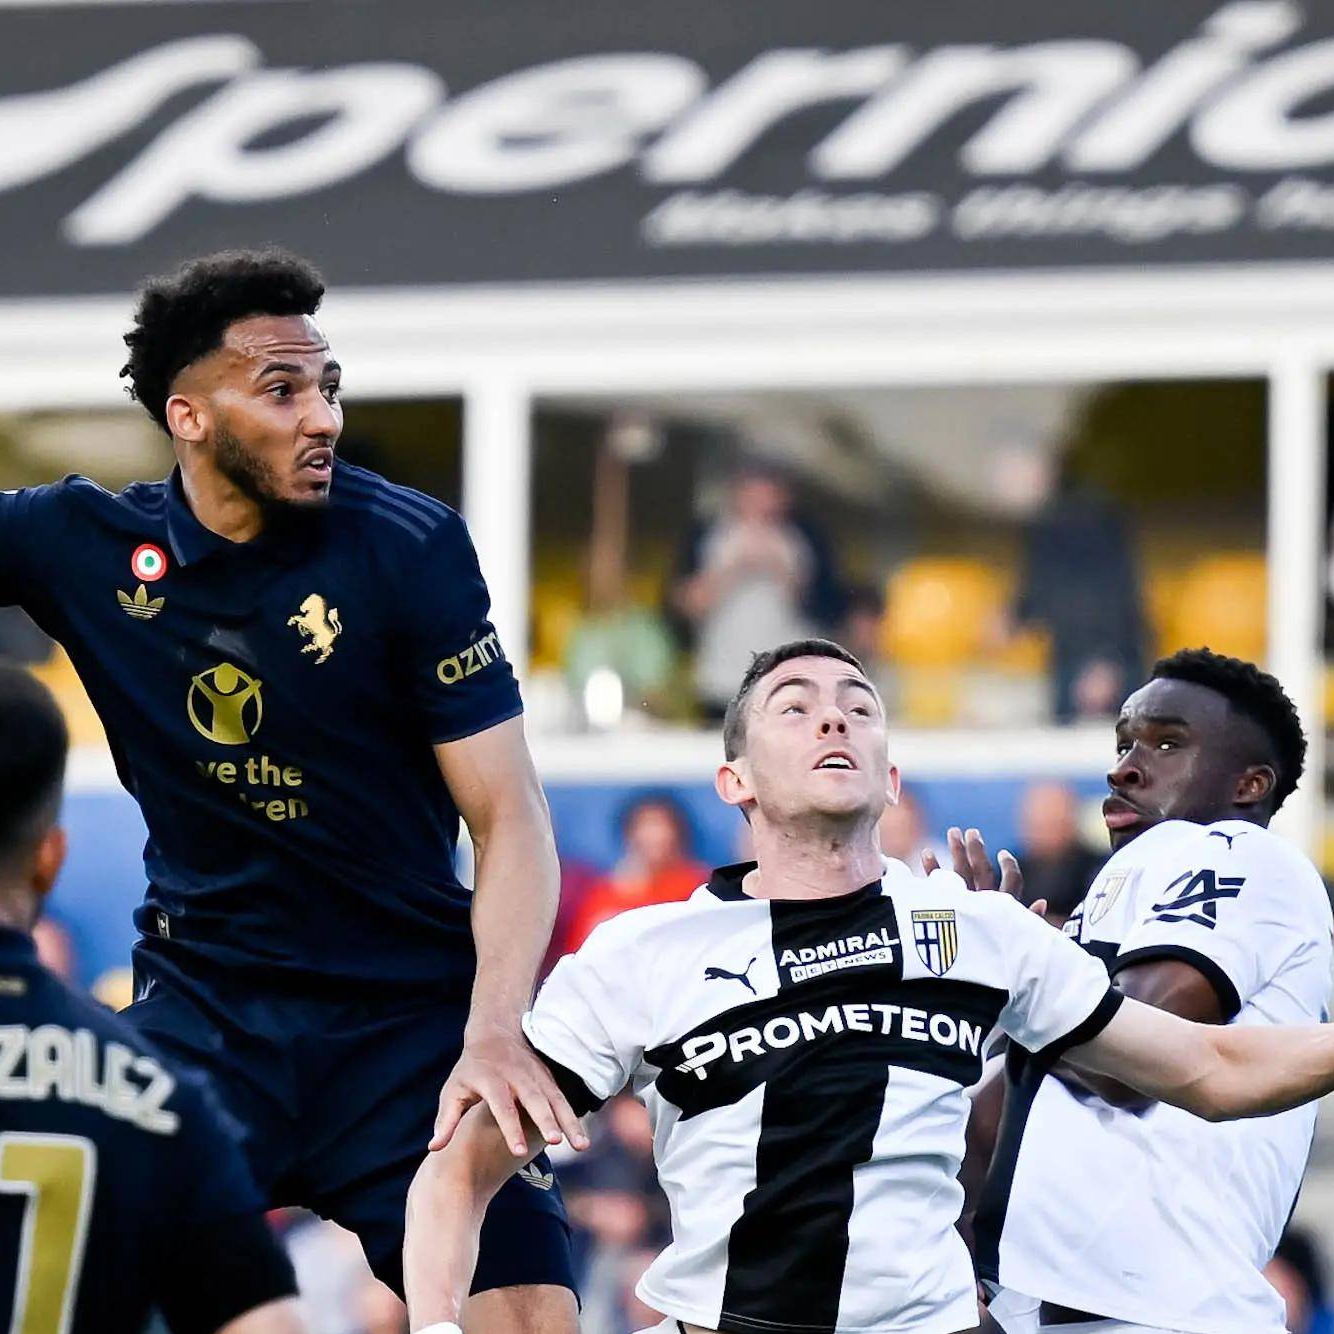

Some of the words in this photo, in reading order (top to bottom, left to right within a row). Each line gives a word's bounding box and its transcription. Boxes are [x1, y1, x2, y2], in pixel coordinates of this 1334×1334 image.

[244, 754, 303, 787] the
[779, 927, 900, 967] ADMIRAL
[675, 1003, 982, 1081] PROMETEON
